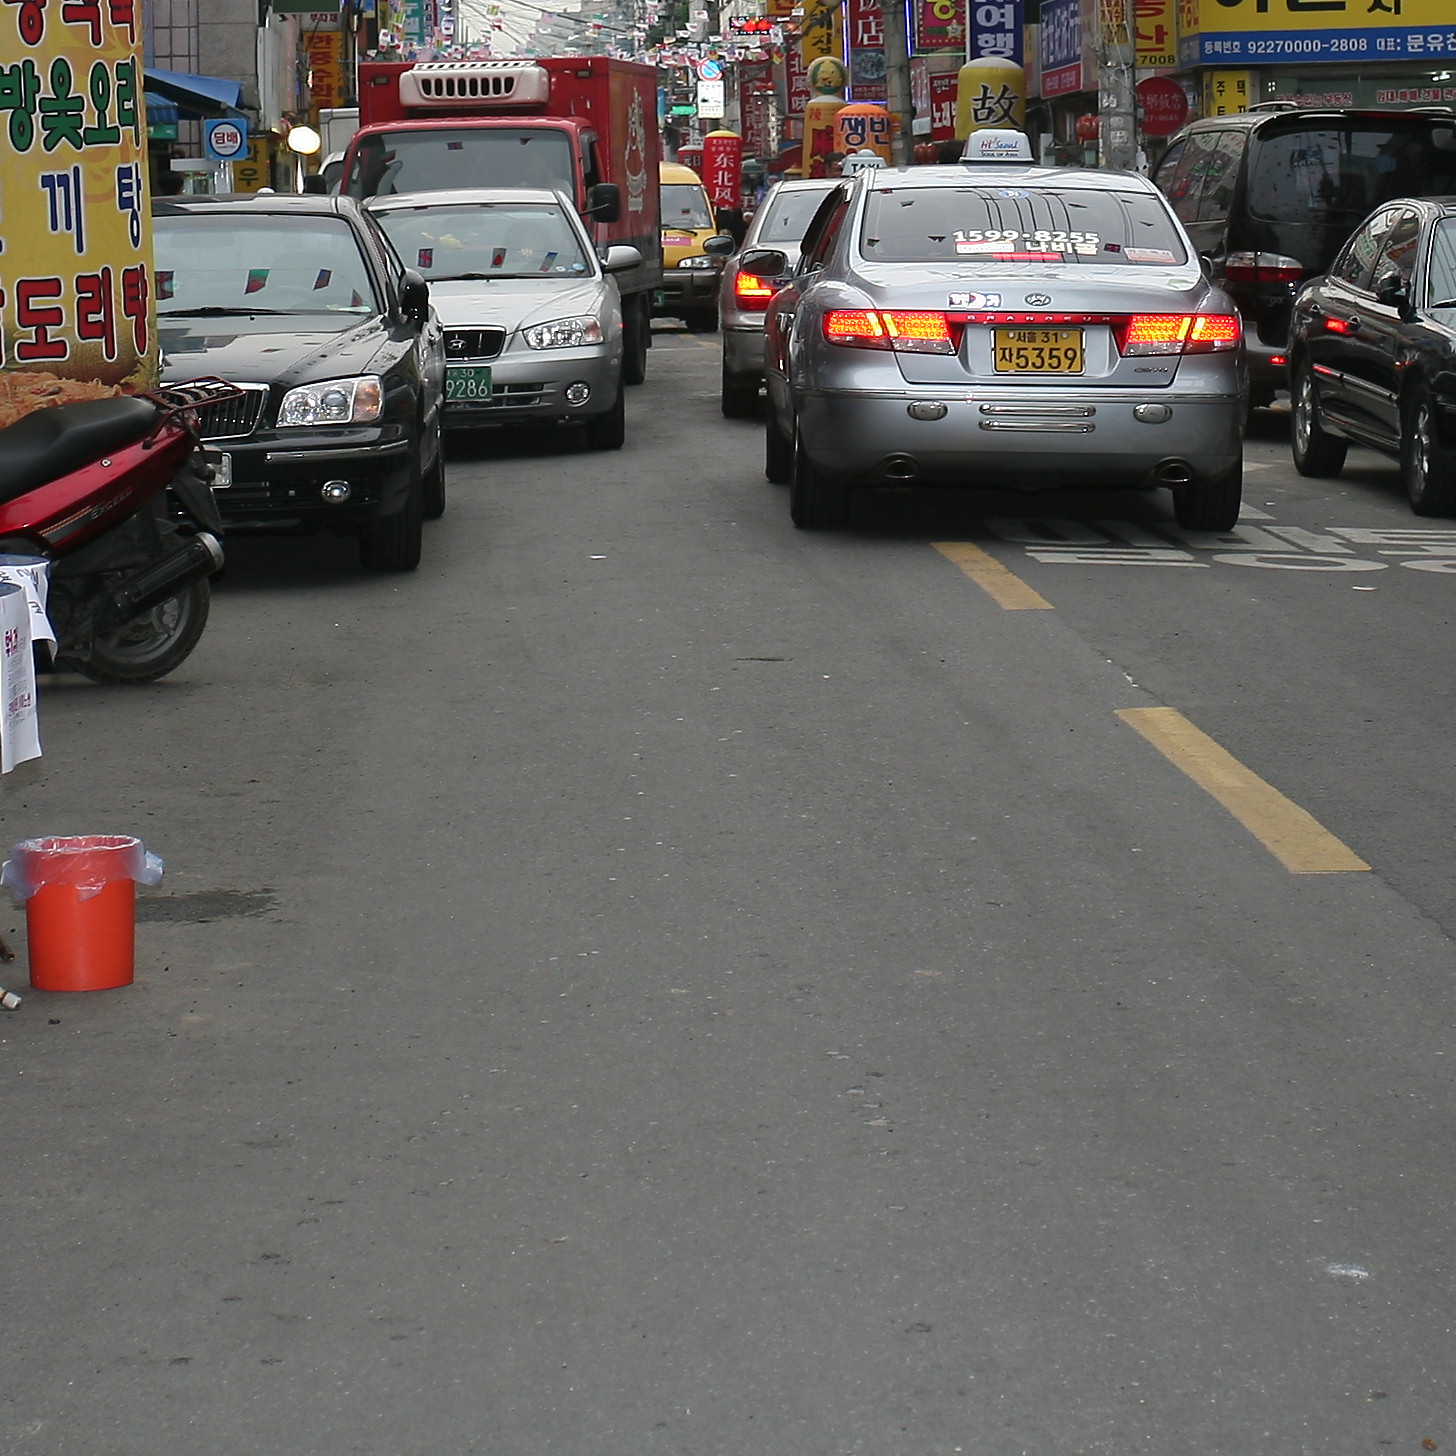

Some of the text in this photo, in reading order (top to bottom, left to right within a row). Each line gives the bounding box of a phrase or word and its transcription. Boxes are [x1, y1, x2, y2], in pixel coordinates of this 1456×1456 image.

[1204, 40, 1242, 55] 등록번호
[1247, 37, 1368, 55] 92270000-2808
[1376, 37, 1402, 52] 대표:
[971, 83, 1020, 128] 故
[214, 131, 239, 145] 담배
[952, 229, 1101, 245] 1599-8255
[1015, 331, 1060, 344] 서울 31
[445, 378, 489, 399] 9286
